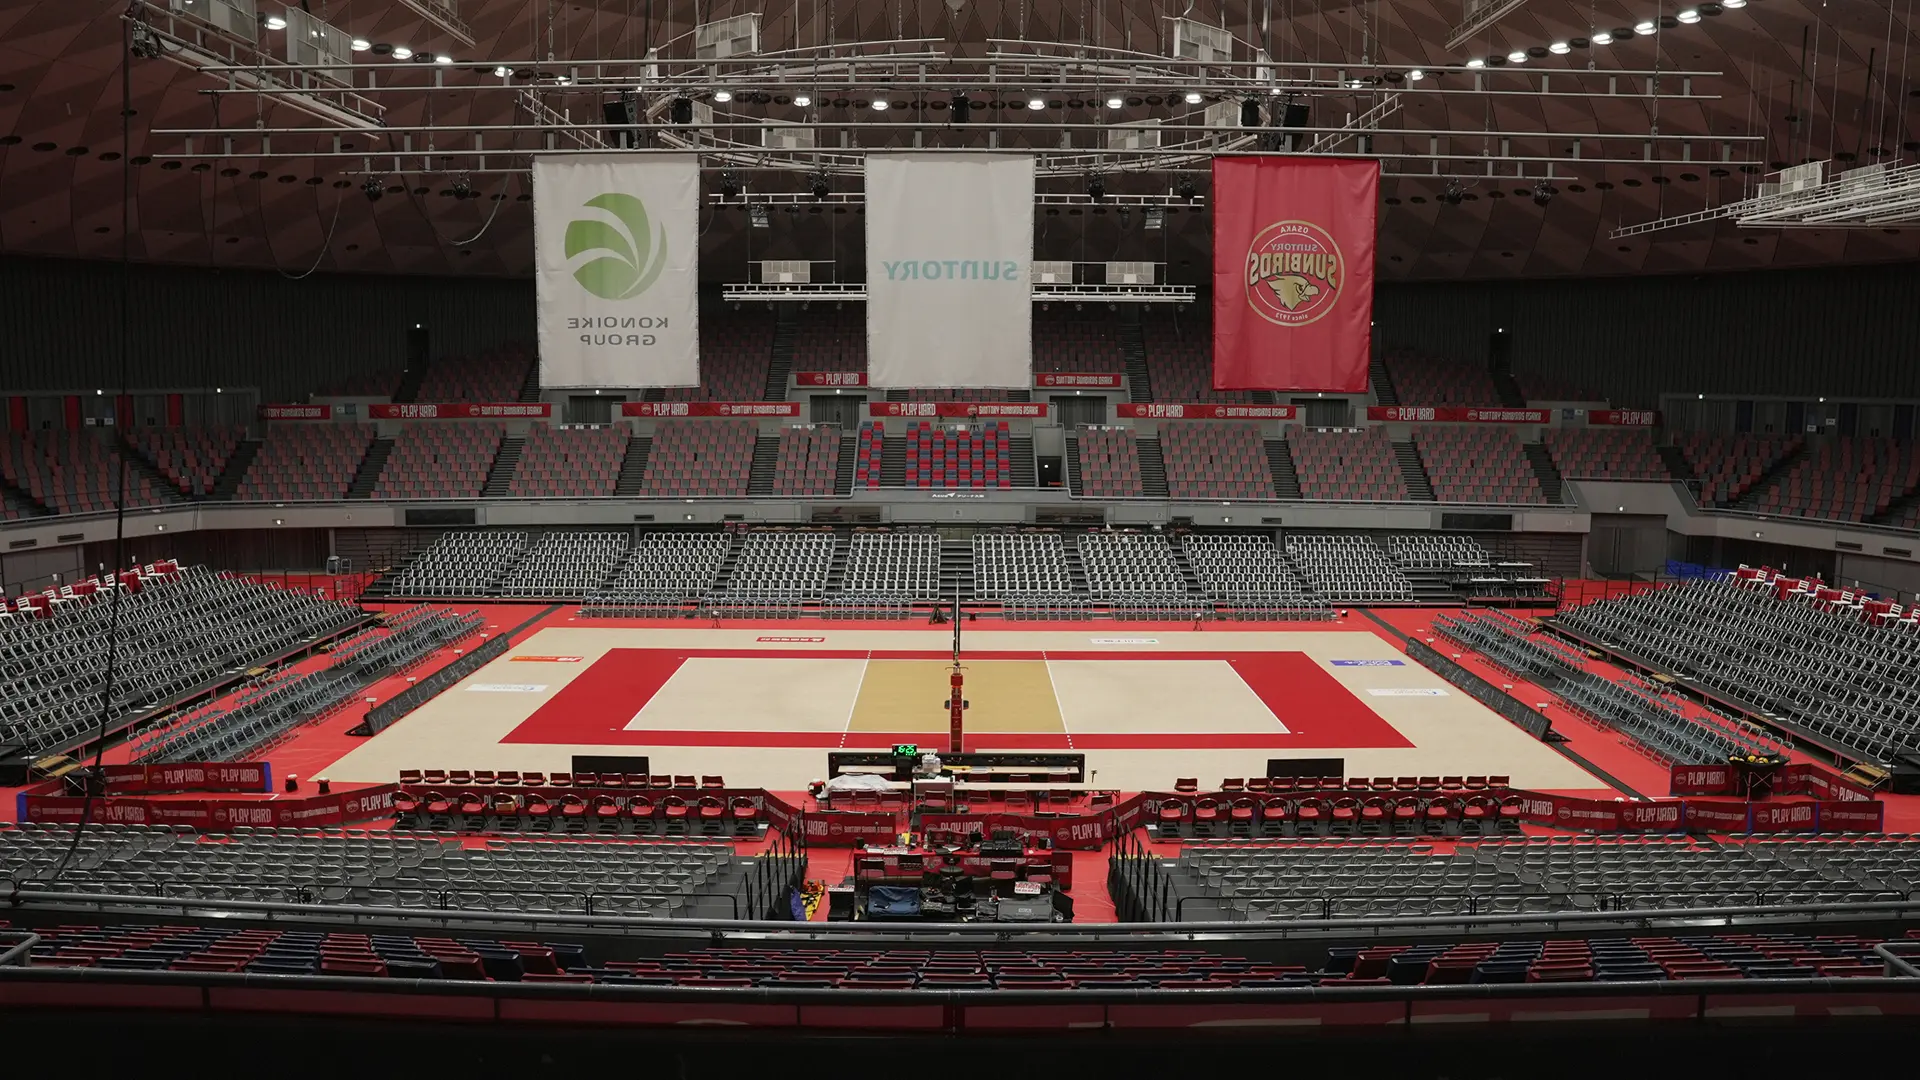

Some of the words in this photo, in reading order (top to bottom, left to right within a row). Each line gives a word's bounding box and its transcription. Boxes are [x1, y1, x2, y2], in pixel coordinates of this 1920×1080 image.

[826, 373, 842, 385] PLAY
[401, 405, 419, 418] PLAY
[653, 403, 670, 416] PLAY
[901, 403, 918, 416] PLAY
[1148, 405, 1166, 418] PLAY
[1399, 408, 1417, 421] PLAY
[1622, 411, 1640, 424] PLAY
[164, 769, 184, 784] PLAY
[185, 768, 204, 783] HARD
[221, 769, 240, 782] PLAY
[240, 769, 259, 782] HARD
[1688, 772, 1706, 785] PLAY
[1706, 771, 1725, 785] HARD
[361, 794, 382, 812] PLAY
[1531, 799, 1553, 816] HARD
[229, 808, 250, 823] PLAY
[250, 808, 271, 823] HARD
[1636, 807, 1656, 822] PLAY
[1656, 807, 1678, 821] HARD
[1772, 808, 1791, 824] PLAY
[1791, 806, 1811, 822] HARD
[807, 820, 828, 835] HARD
[1072, 822, 1093, 840] PLAY
